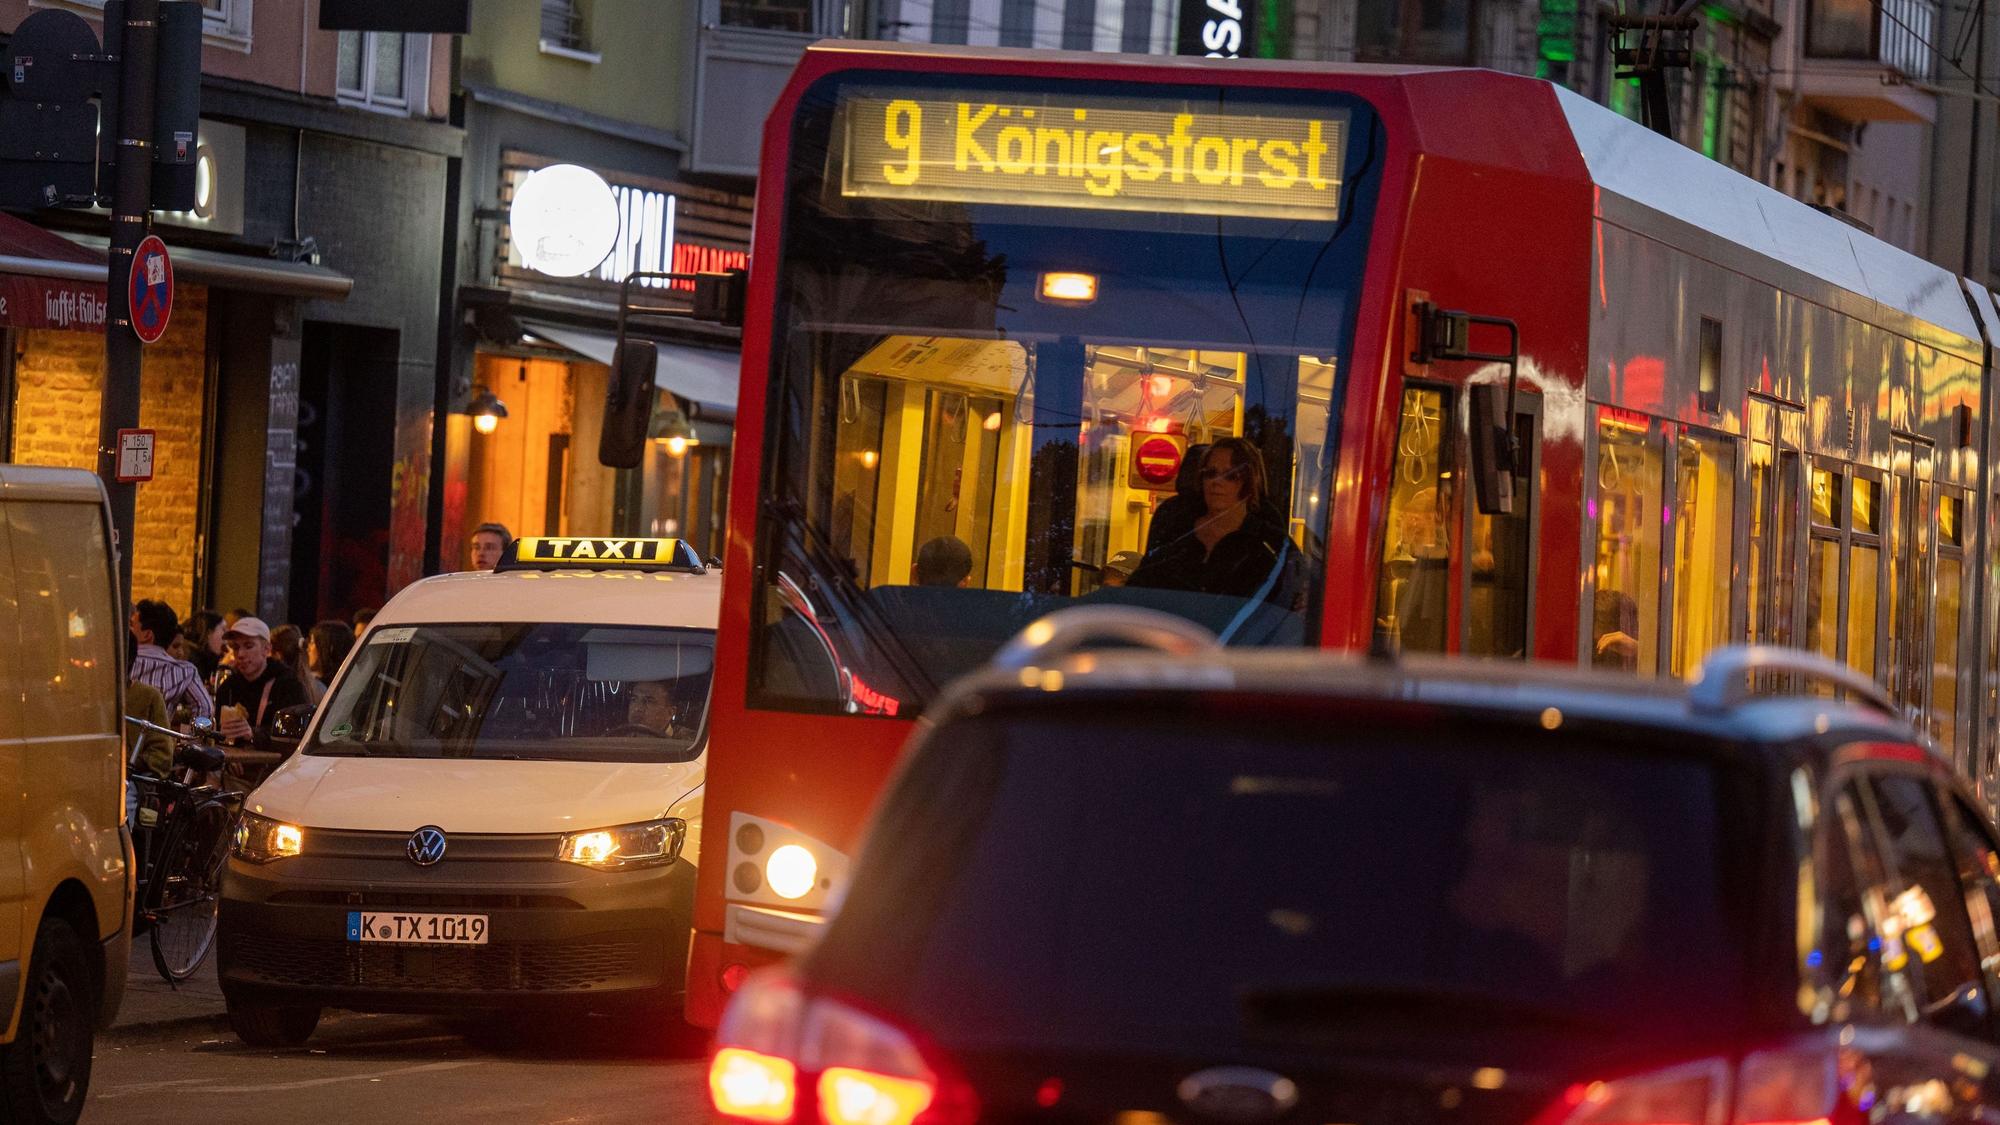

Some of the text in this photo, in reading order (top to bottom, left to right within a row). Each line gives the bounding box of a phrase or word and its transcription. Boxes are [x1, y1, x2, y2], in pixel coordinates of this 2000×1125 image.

[883, 100, 1328, 197] 9 Königsforst
[133, 435, 145, 446] 150
[548, 540, 643, 558] TAXI
[362, 915, 376, 938] K
[428, 918, 485, 940] 1019
